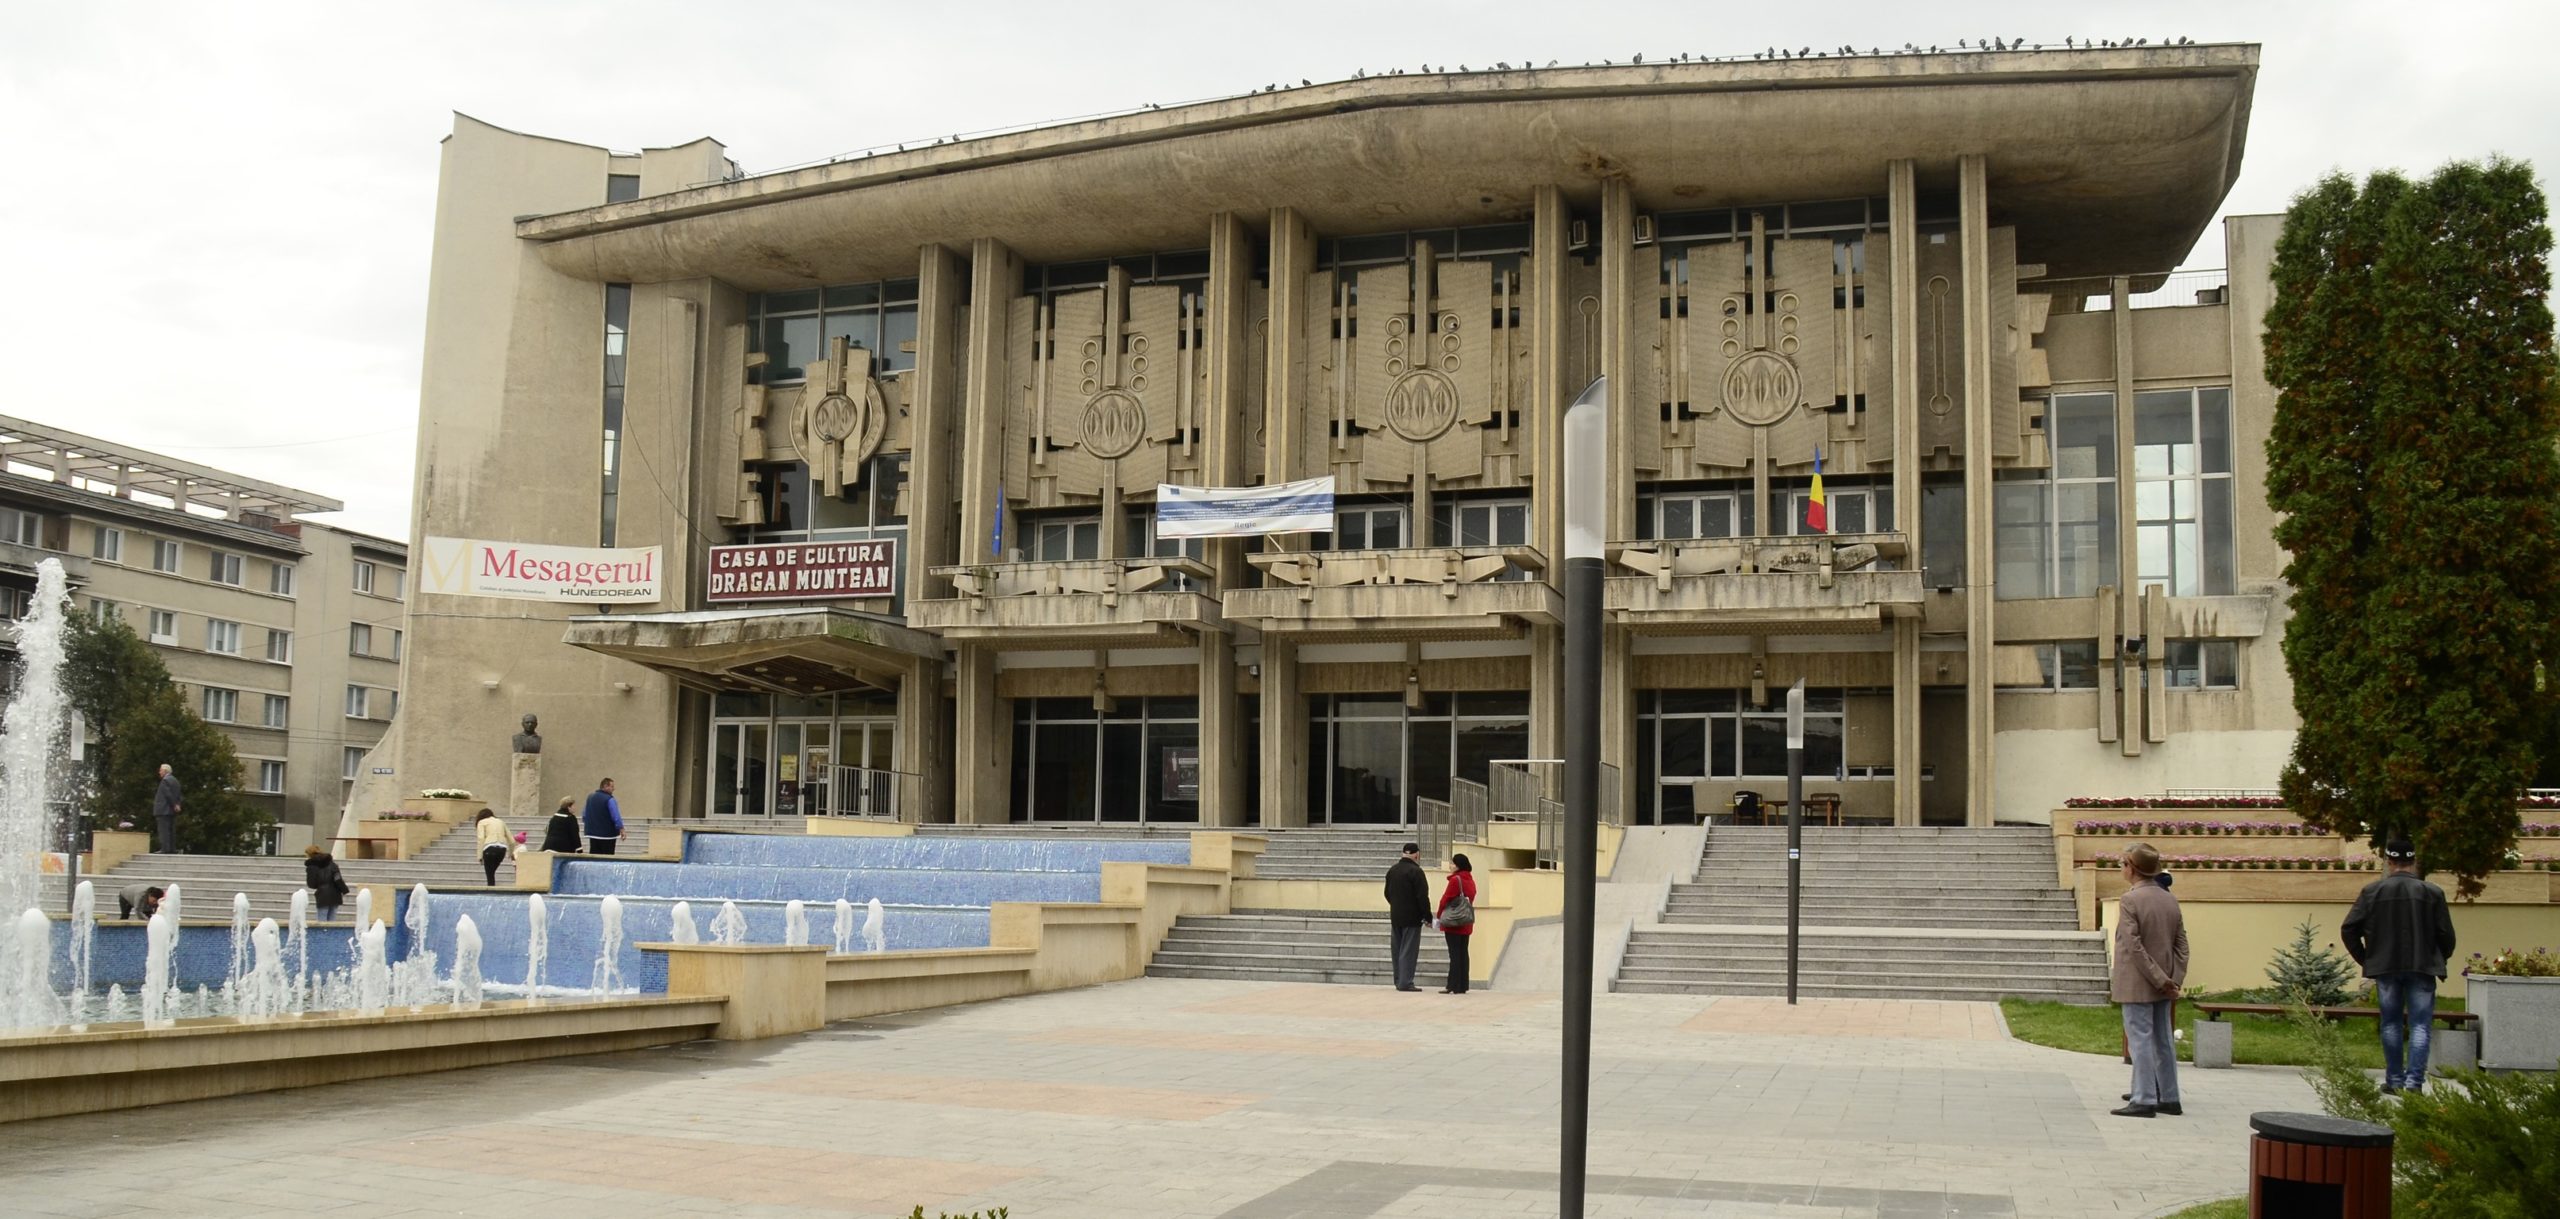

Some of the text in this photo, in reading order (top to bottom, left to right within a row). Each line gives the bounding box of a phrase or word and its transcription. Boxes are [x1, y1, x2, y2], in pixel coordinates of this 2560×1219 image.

[480, 547, 653, 587] Mesagerul
[719, 545, 884, 568] CASA DE CULTURA
[560, 587, 652, 597] HUNEDOREAN
[712, 566, 889, 594] DRAGAN MUNTEAN
